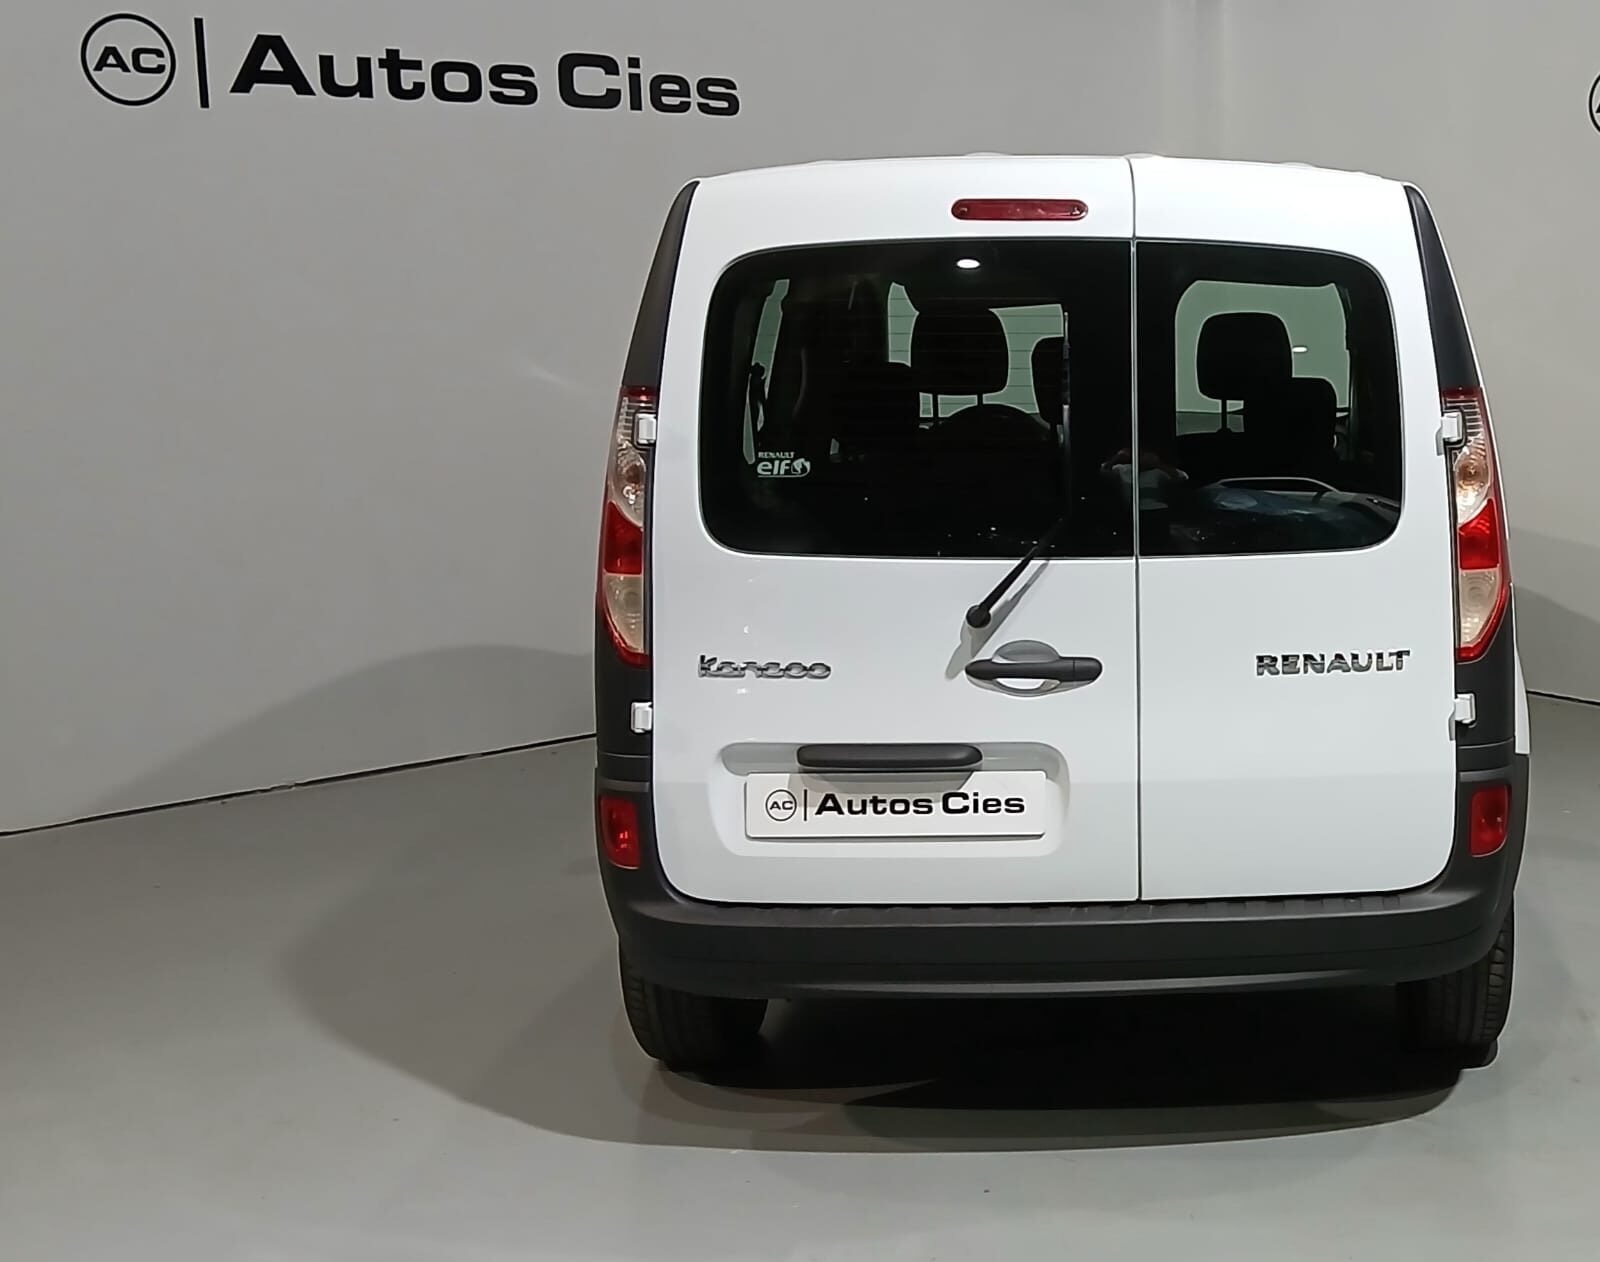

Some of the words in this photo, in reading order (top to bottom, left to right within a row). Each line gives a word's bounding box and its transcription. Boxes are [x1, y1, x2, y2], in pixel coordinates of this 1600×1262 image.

[92, 45, 167, 75] AC
[230, 34, 539, 106] Autos
[557, 53, 741, 117] Cies
[757, 460, 792, 475] elf
[758, 451, 795, 459] RENAULT
[1256, 650, 1411, 676] RENAULT
[769, 800, 794, 811] AC
[814, 793, 934, 816] Autos
[941, 791, 1026, 814] Cies
